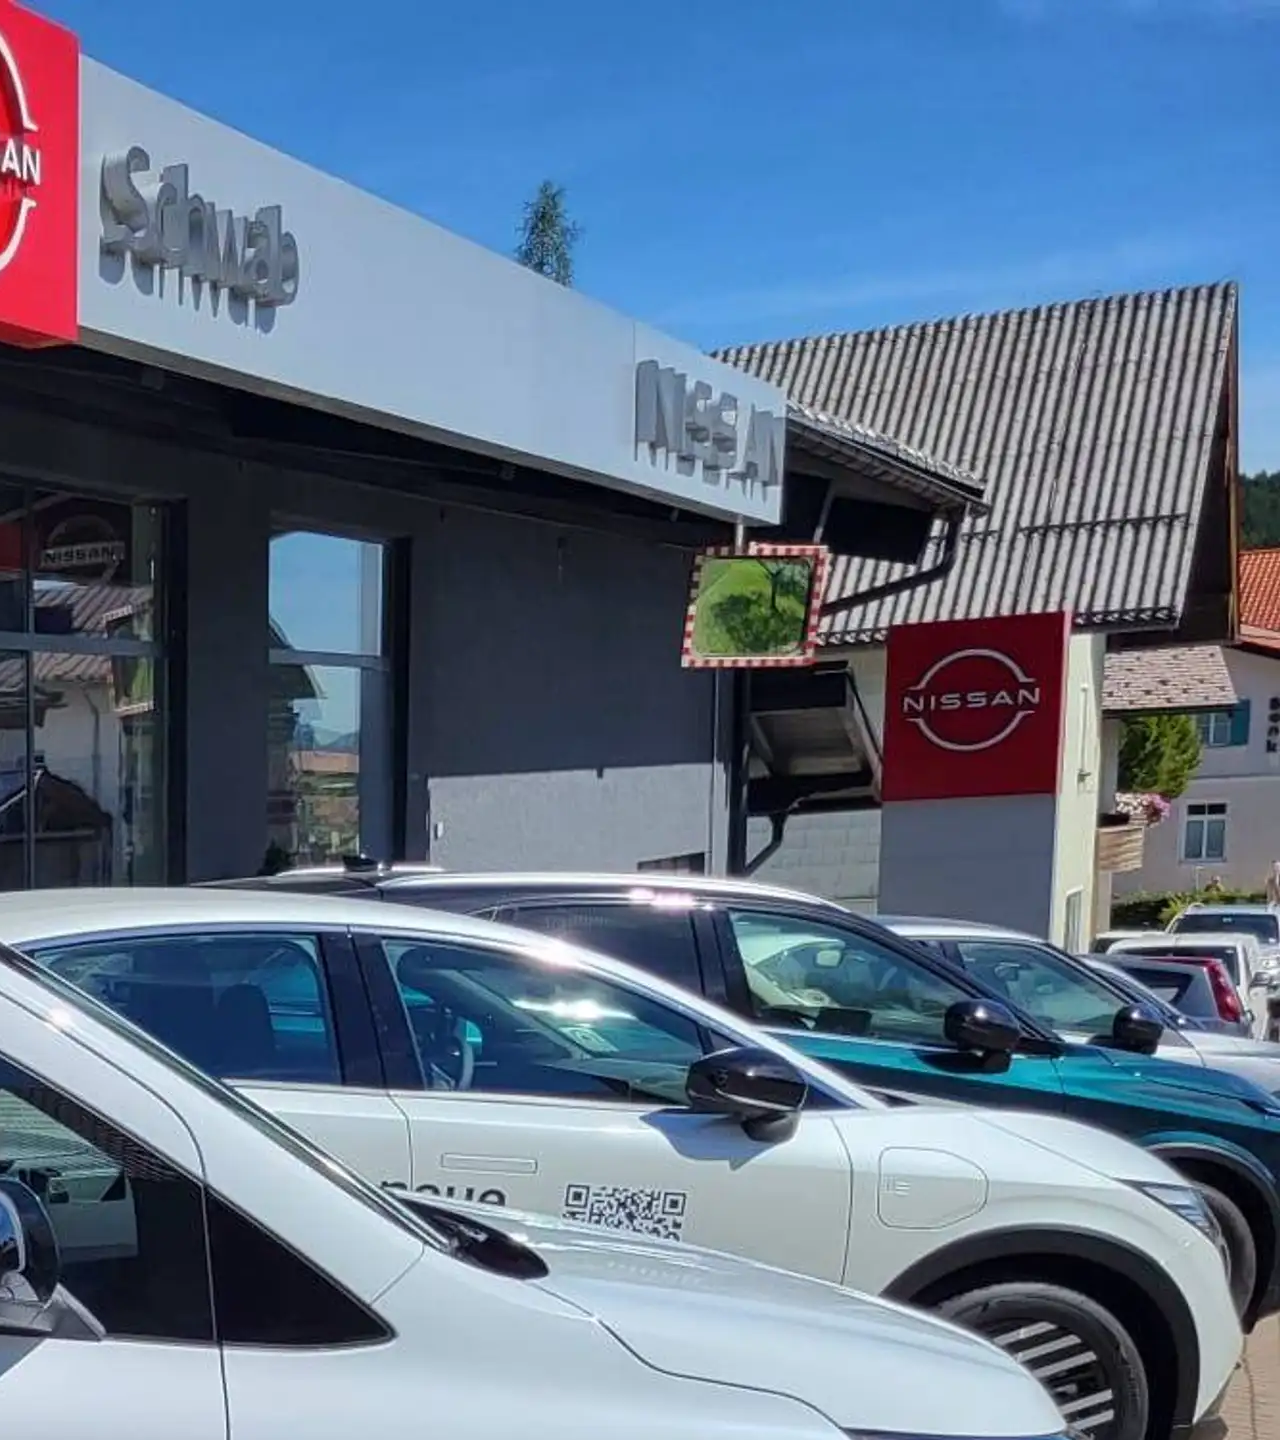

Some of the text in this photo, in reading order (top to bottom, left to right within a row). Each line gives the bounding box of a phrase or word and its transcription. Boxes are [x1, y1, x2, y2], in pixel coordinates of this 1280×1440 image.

[99, 146, 300, 306] Schwab
[635, 360, 787, 487] NISSAN
[903, 687, 1040, 713] NISSAN
